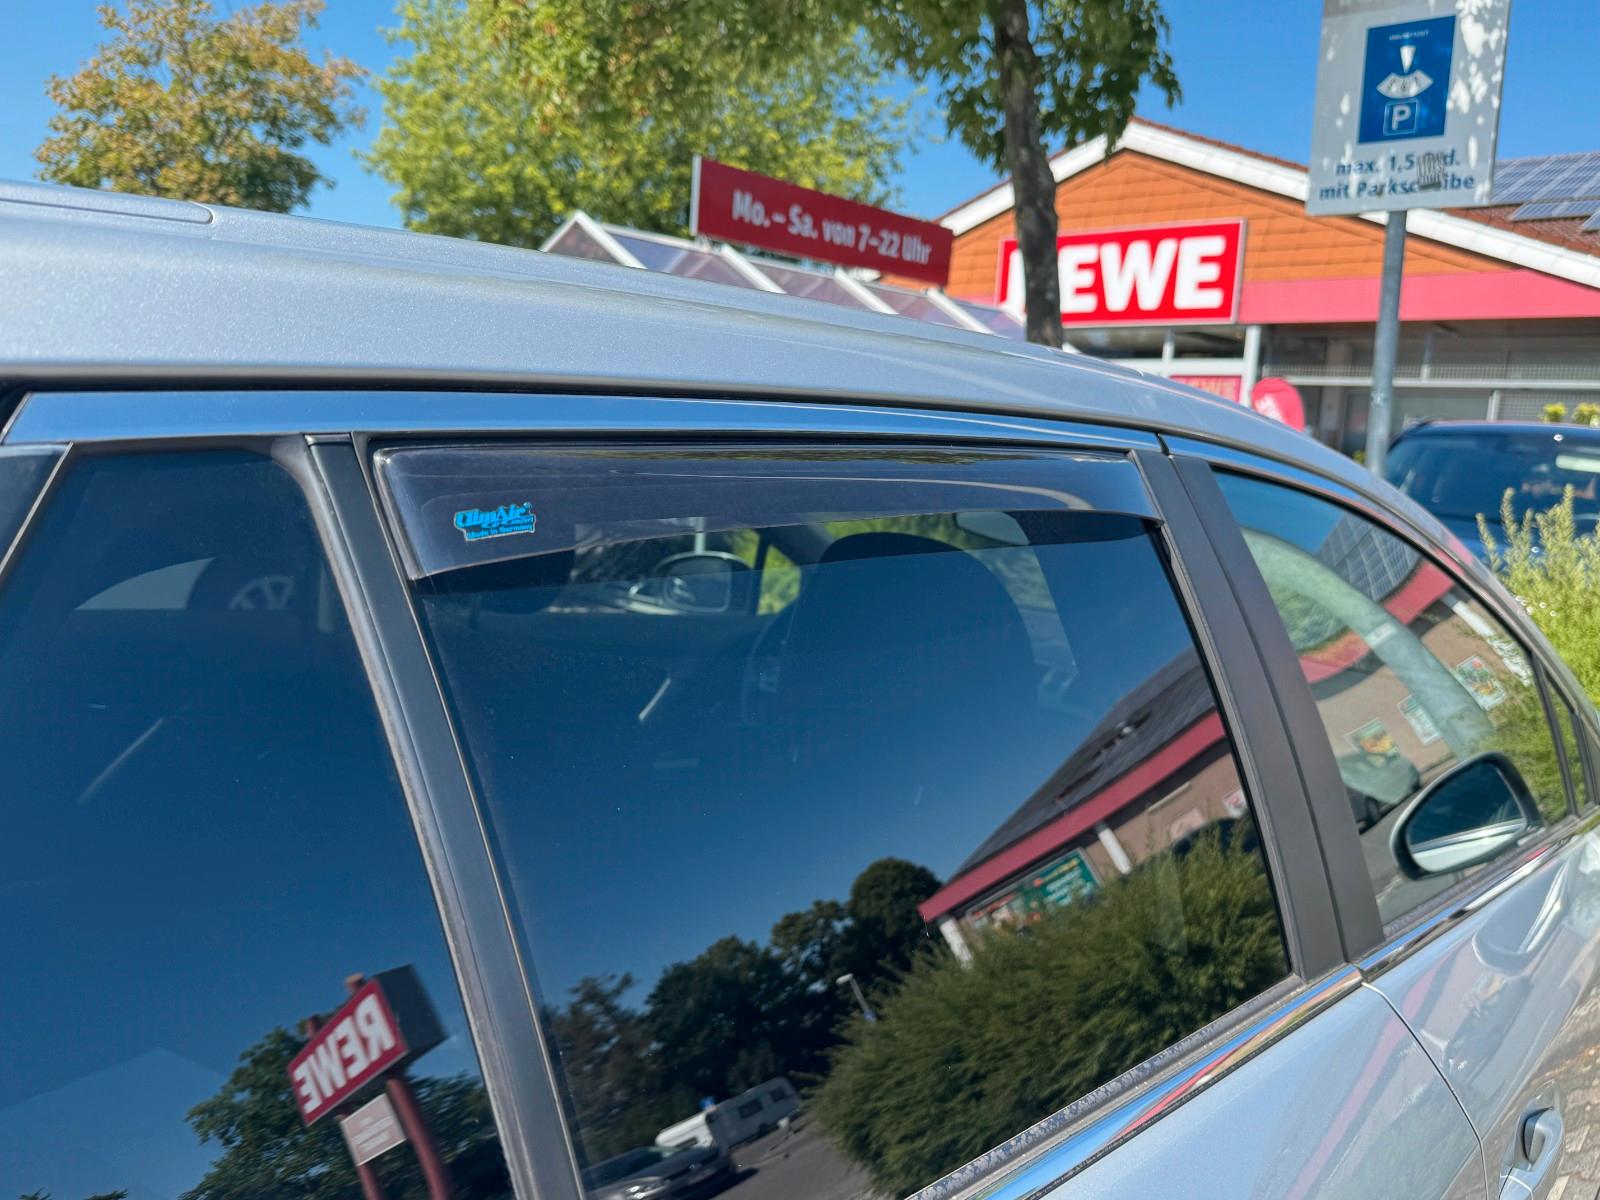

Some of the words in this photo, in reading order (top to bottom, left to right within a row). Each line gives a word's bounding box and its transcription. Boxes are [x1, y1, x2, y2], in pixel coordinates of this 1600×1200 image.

[1391, 104, 1411, 131] P
[1335, 157, 1380, 177] max.
[1319, 182, 1350, 201] mit
[1356, 172, 1475, 198] Parkscibe
[822, 219, 855, 249] von
[901, 233, 932, 265] Uhr
[466, 530, 489, 540] Made
[499, 524, 534, 534] Germany
